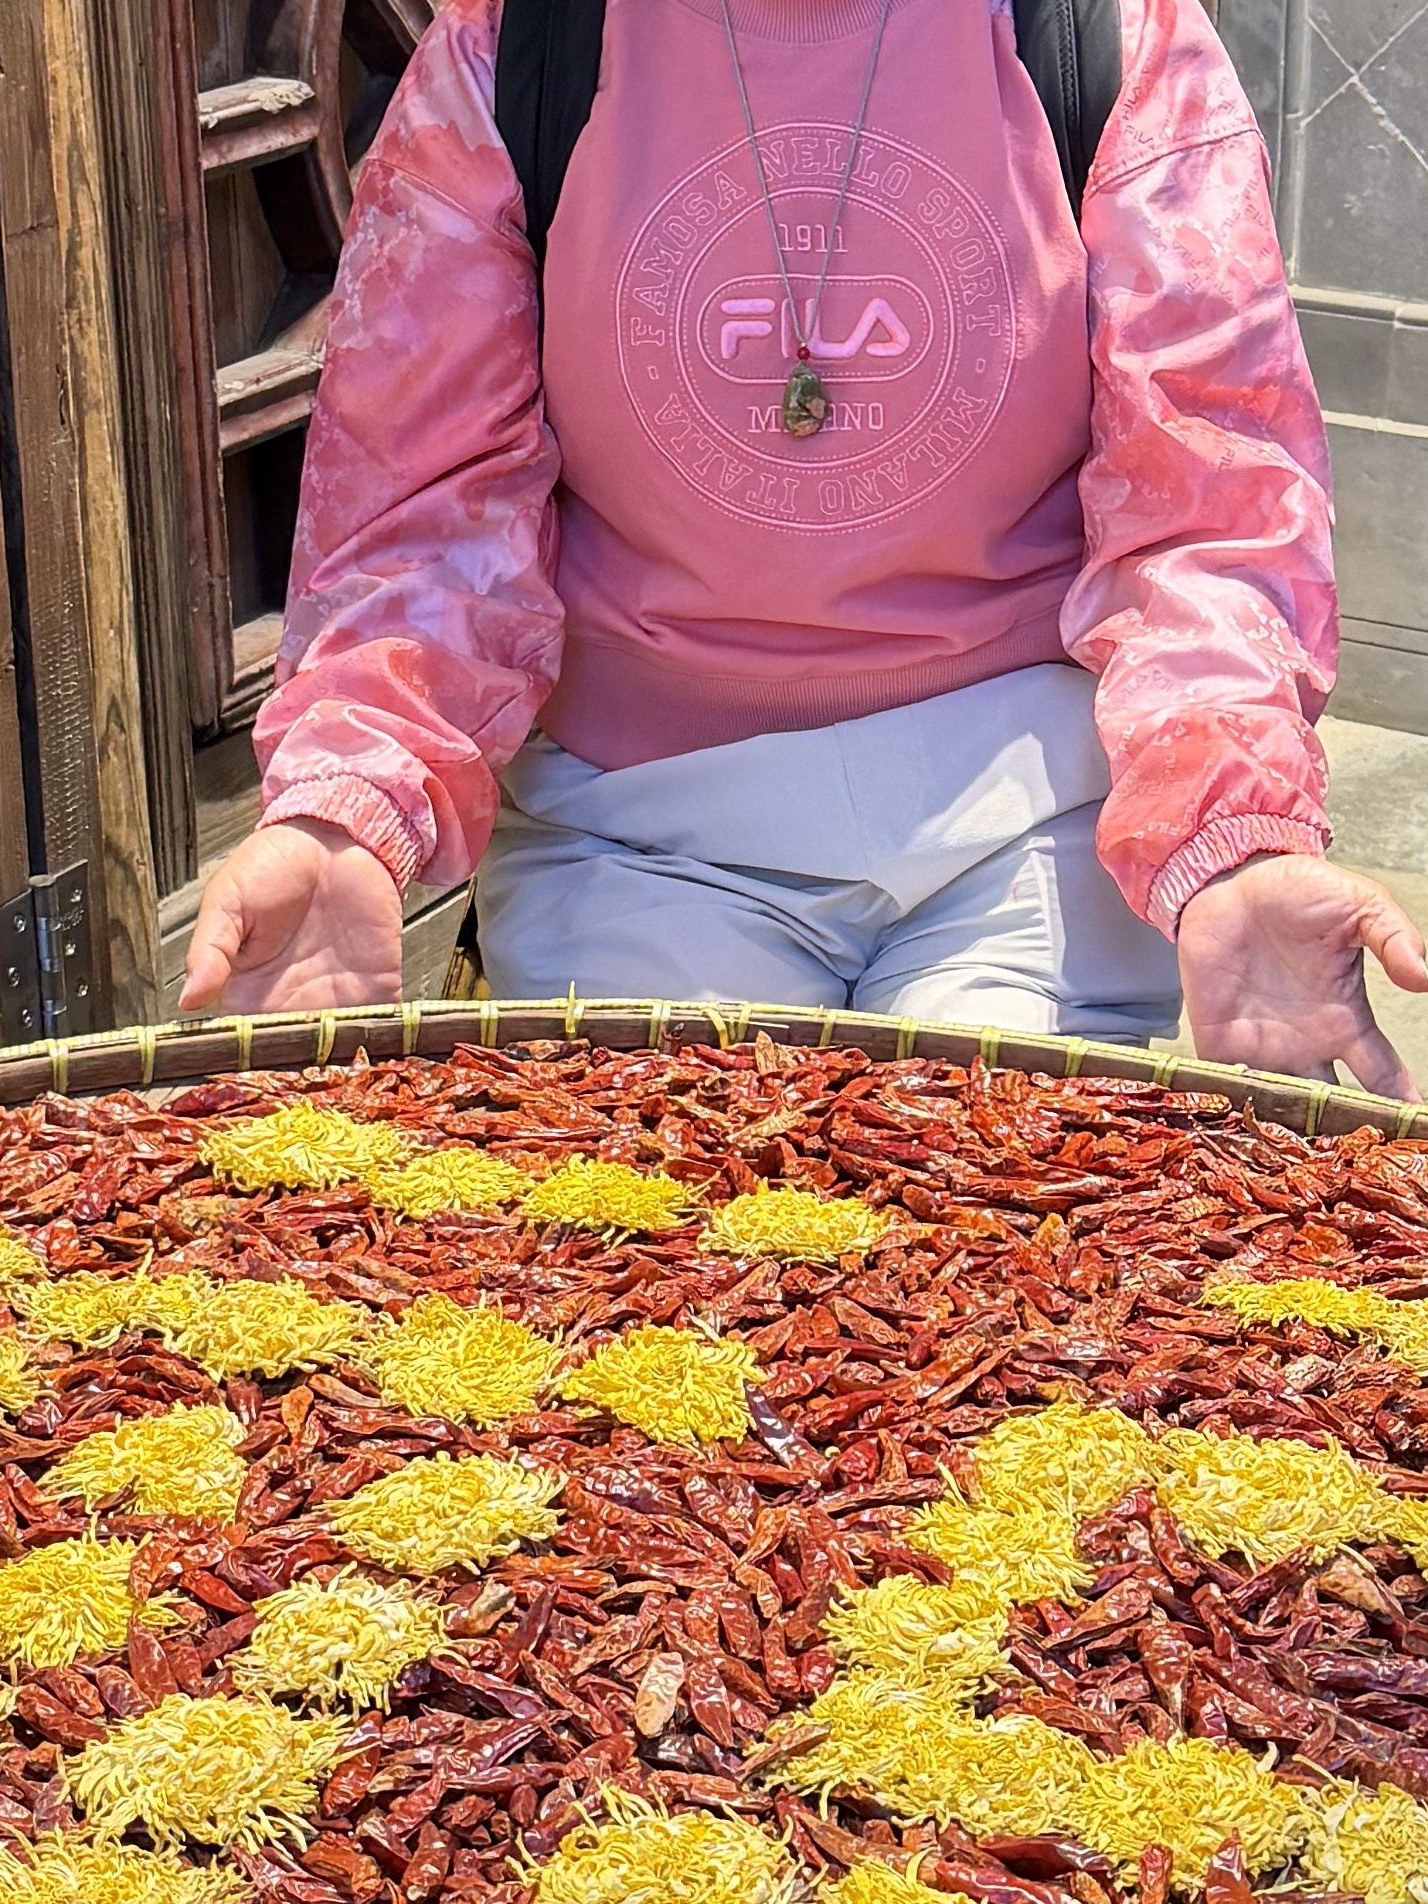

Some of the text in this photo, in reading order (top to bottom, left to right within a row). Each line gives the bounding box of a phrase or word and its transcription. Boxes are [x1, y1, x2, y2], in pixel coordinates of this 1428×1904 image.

[630, 137, 1002, 346] FAMOSA NELLO SPORT
[777, 223, 849, 253] 1911
[721, 298, 911, 360] FILA
[747, 402, 884, 433] MANO
[654, 386, 988, 516] MILANO ITALIA
